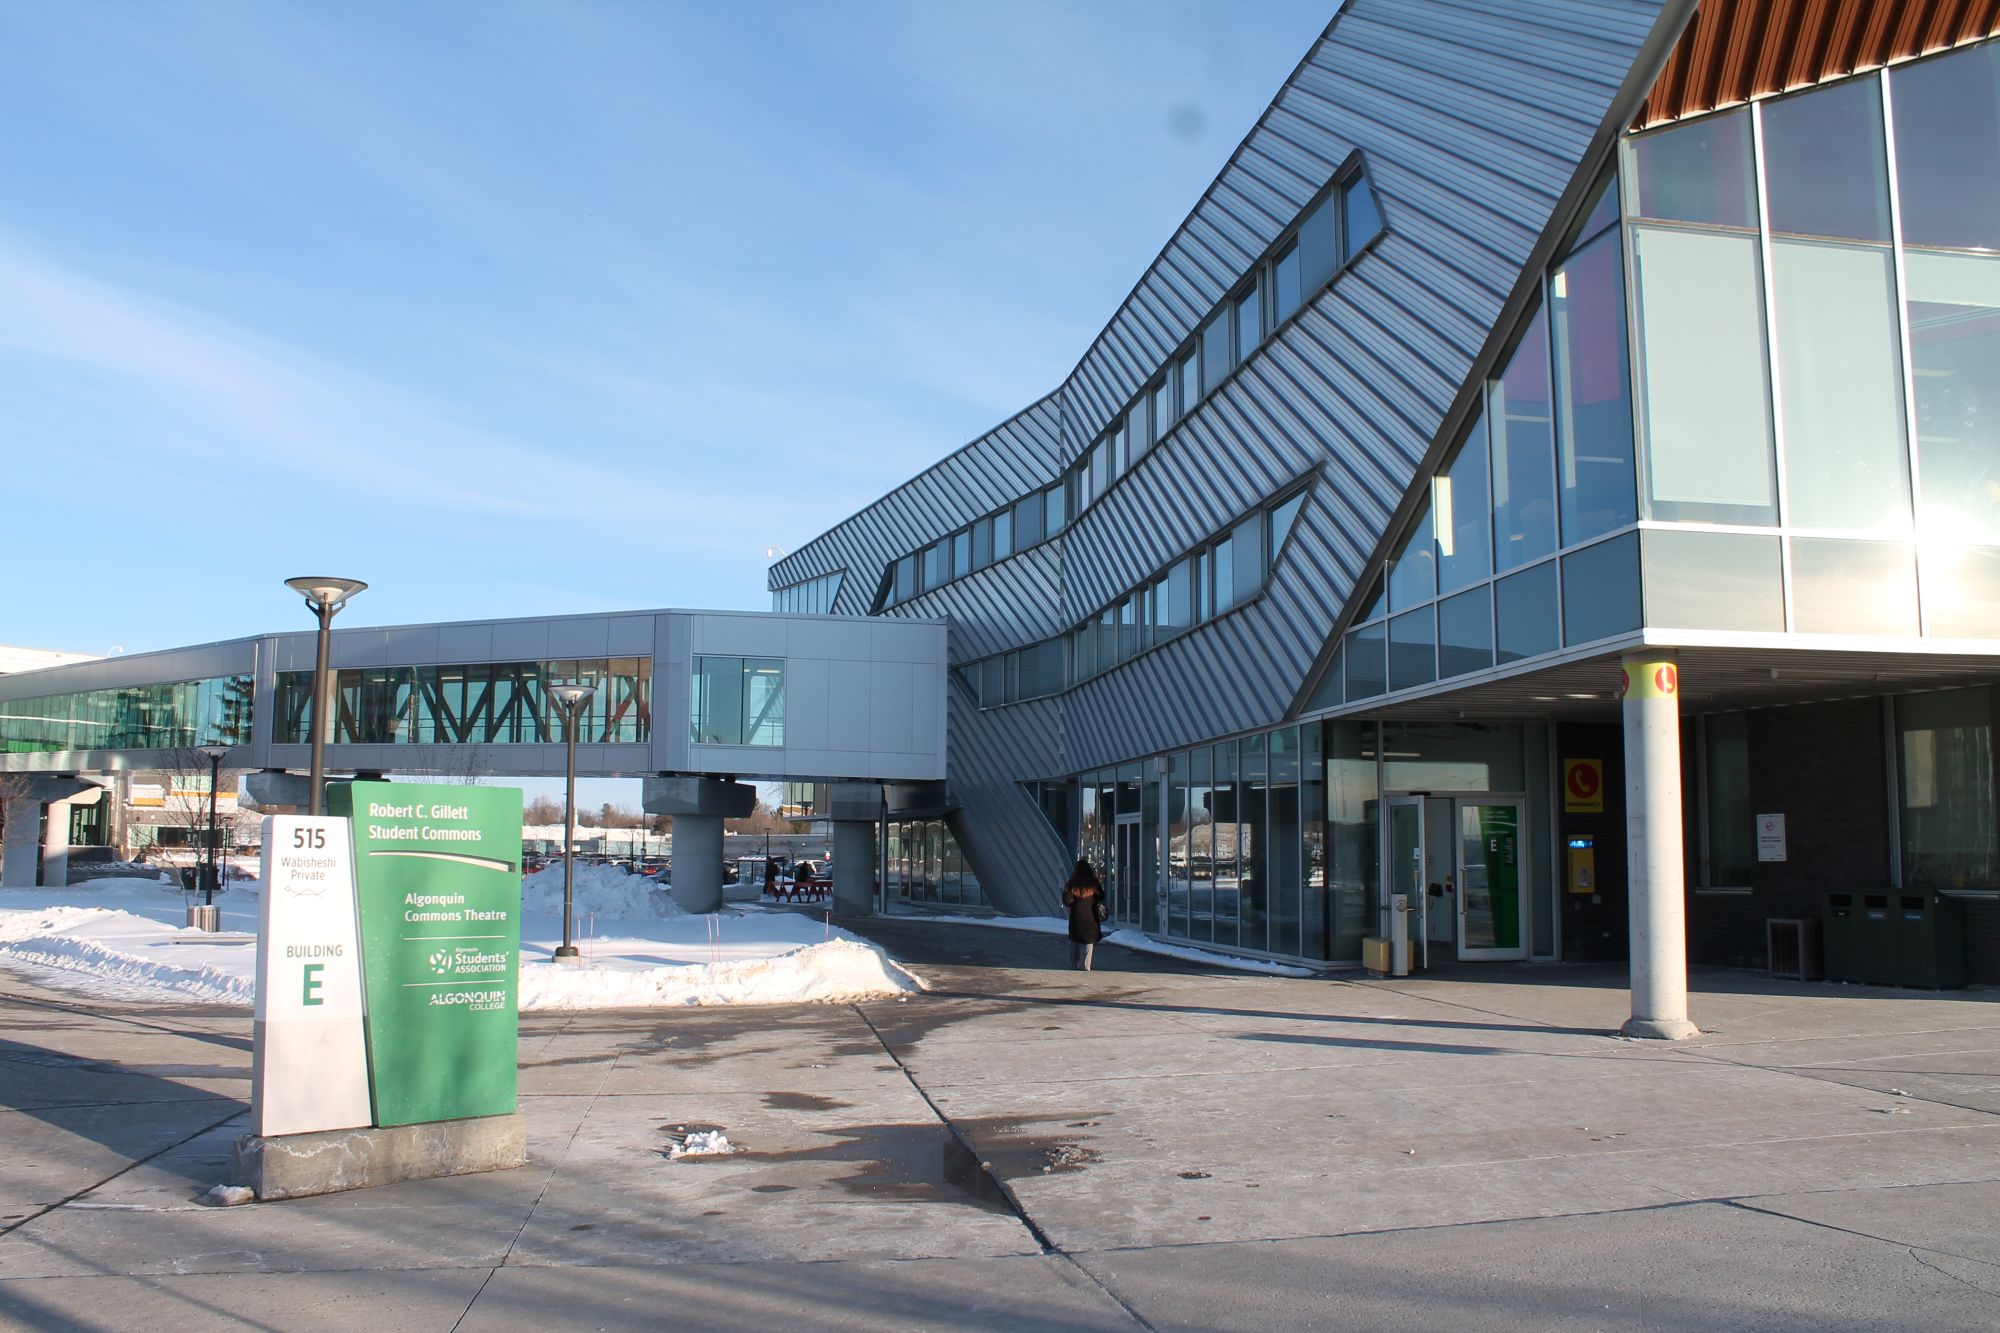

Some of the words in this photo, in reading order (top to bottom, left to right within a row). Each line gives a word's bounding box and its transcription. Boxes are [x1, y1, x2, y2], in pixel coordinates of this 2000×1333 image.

[369, 802, 413, 818] Robert
[415, 803, 428, 819] C.
[430, 804, 469, 820] Gillett
[293, 827, 326, 849] 515
[368, 824, 419, 840] Student
[421, 825, 482, 841] Commons
[290, 869, 326, 880] Private
[404, 892, 465, 907] Algonquin
[404, 910, 462, 922] Commons
[463, 908, 507, 921] Theatre
[286, 944, 343, 958] BUILDING
[454, 964, 507, 974] ASSOCIATION
[303, 963, 324, 1006] E
[429, 990, 506, 1005] ALGONQUIN
[469, 1002, 505, 1011] COLLEGE
